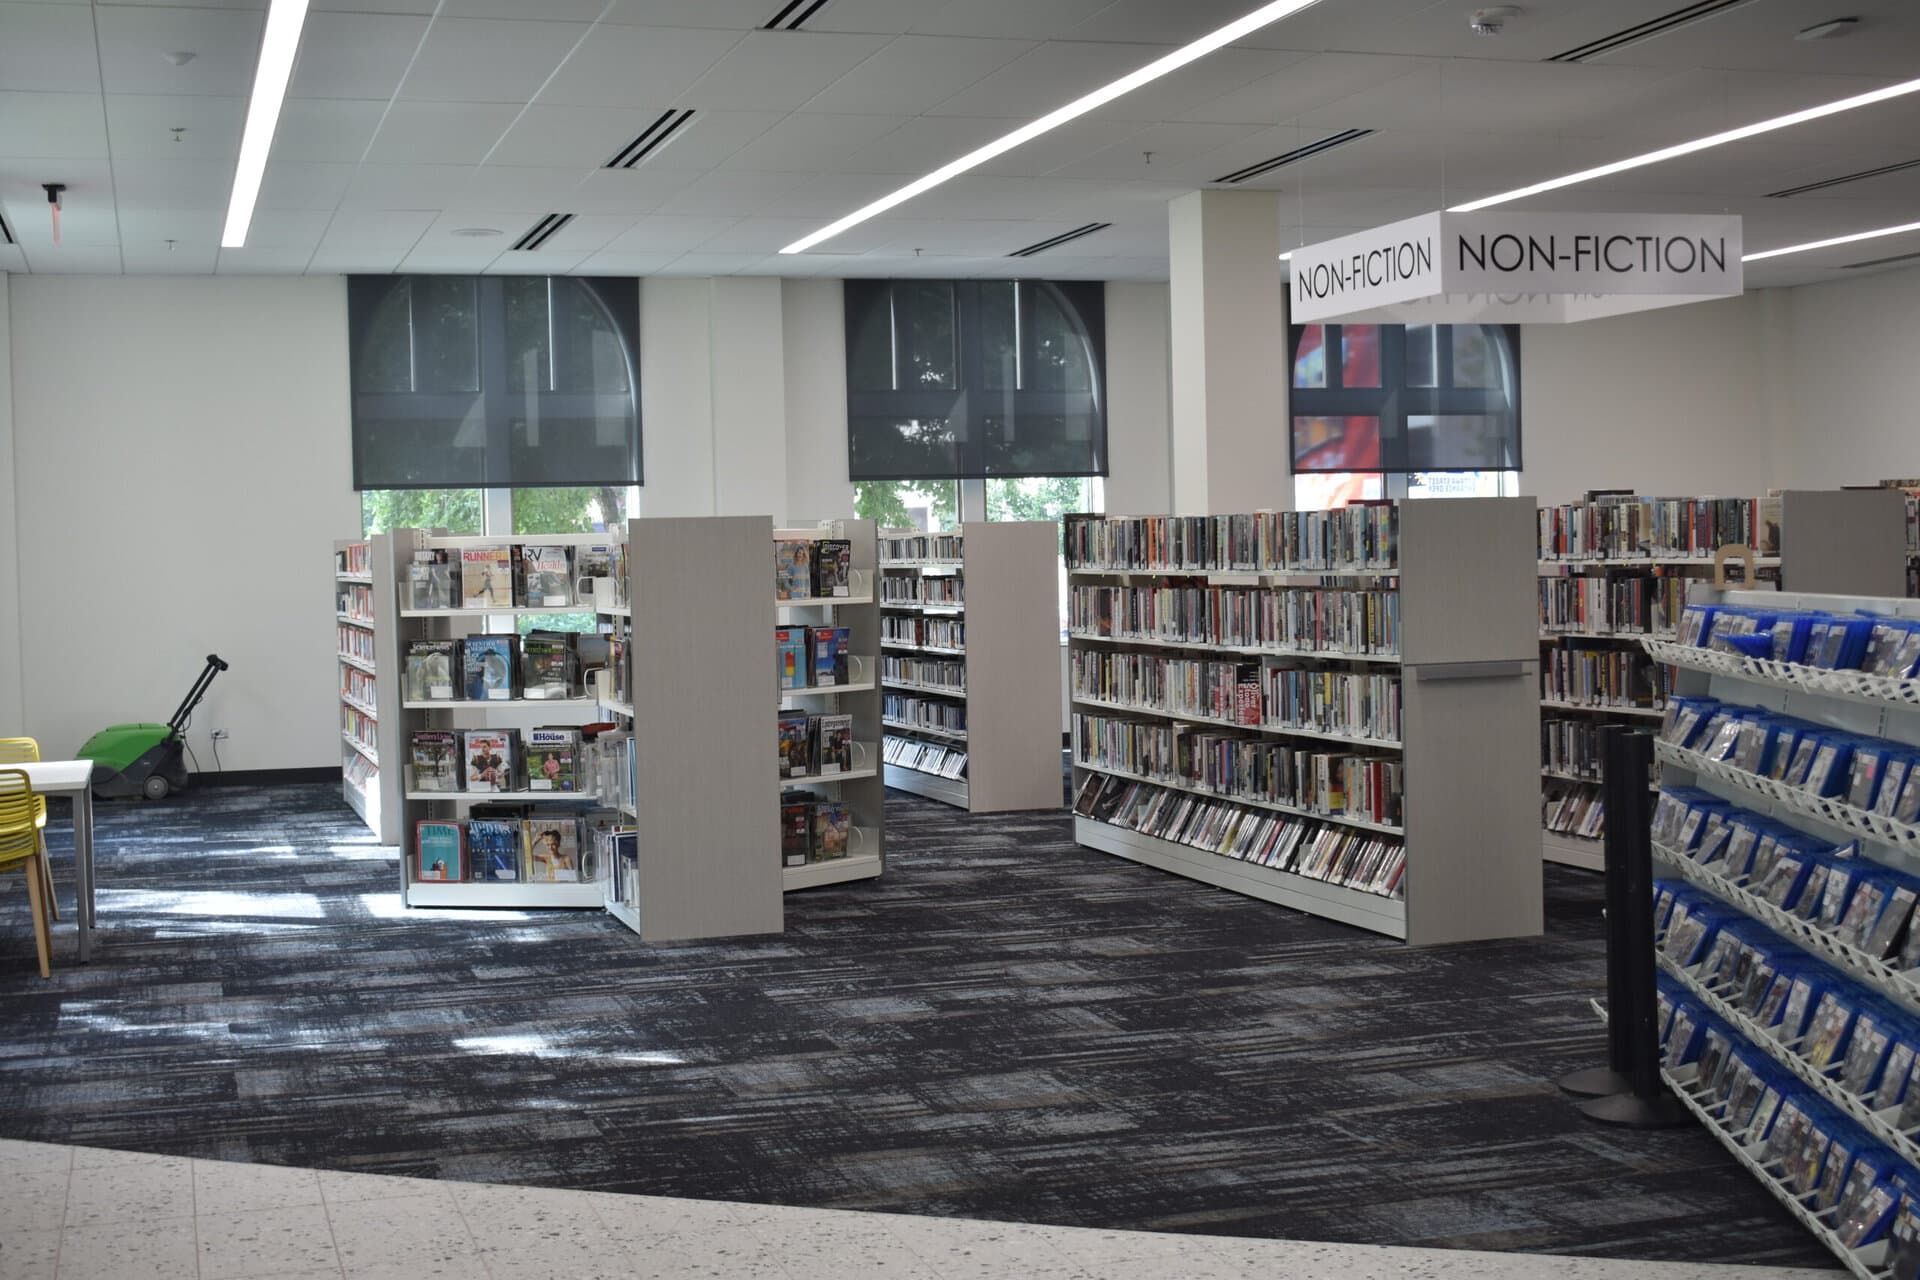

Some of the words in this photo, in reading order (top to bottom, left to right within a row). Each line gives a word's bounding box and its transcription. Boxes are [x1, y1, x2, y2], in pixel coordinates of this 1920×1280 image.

[1299, 237, 1432, 302] NON-FICTION
[1458, 234, 1726, 274] NON-FICTION
[538, 732, 565, 741] House
